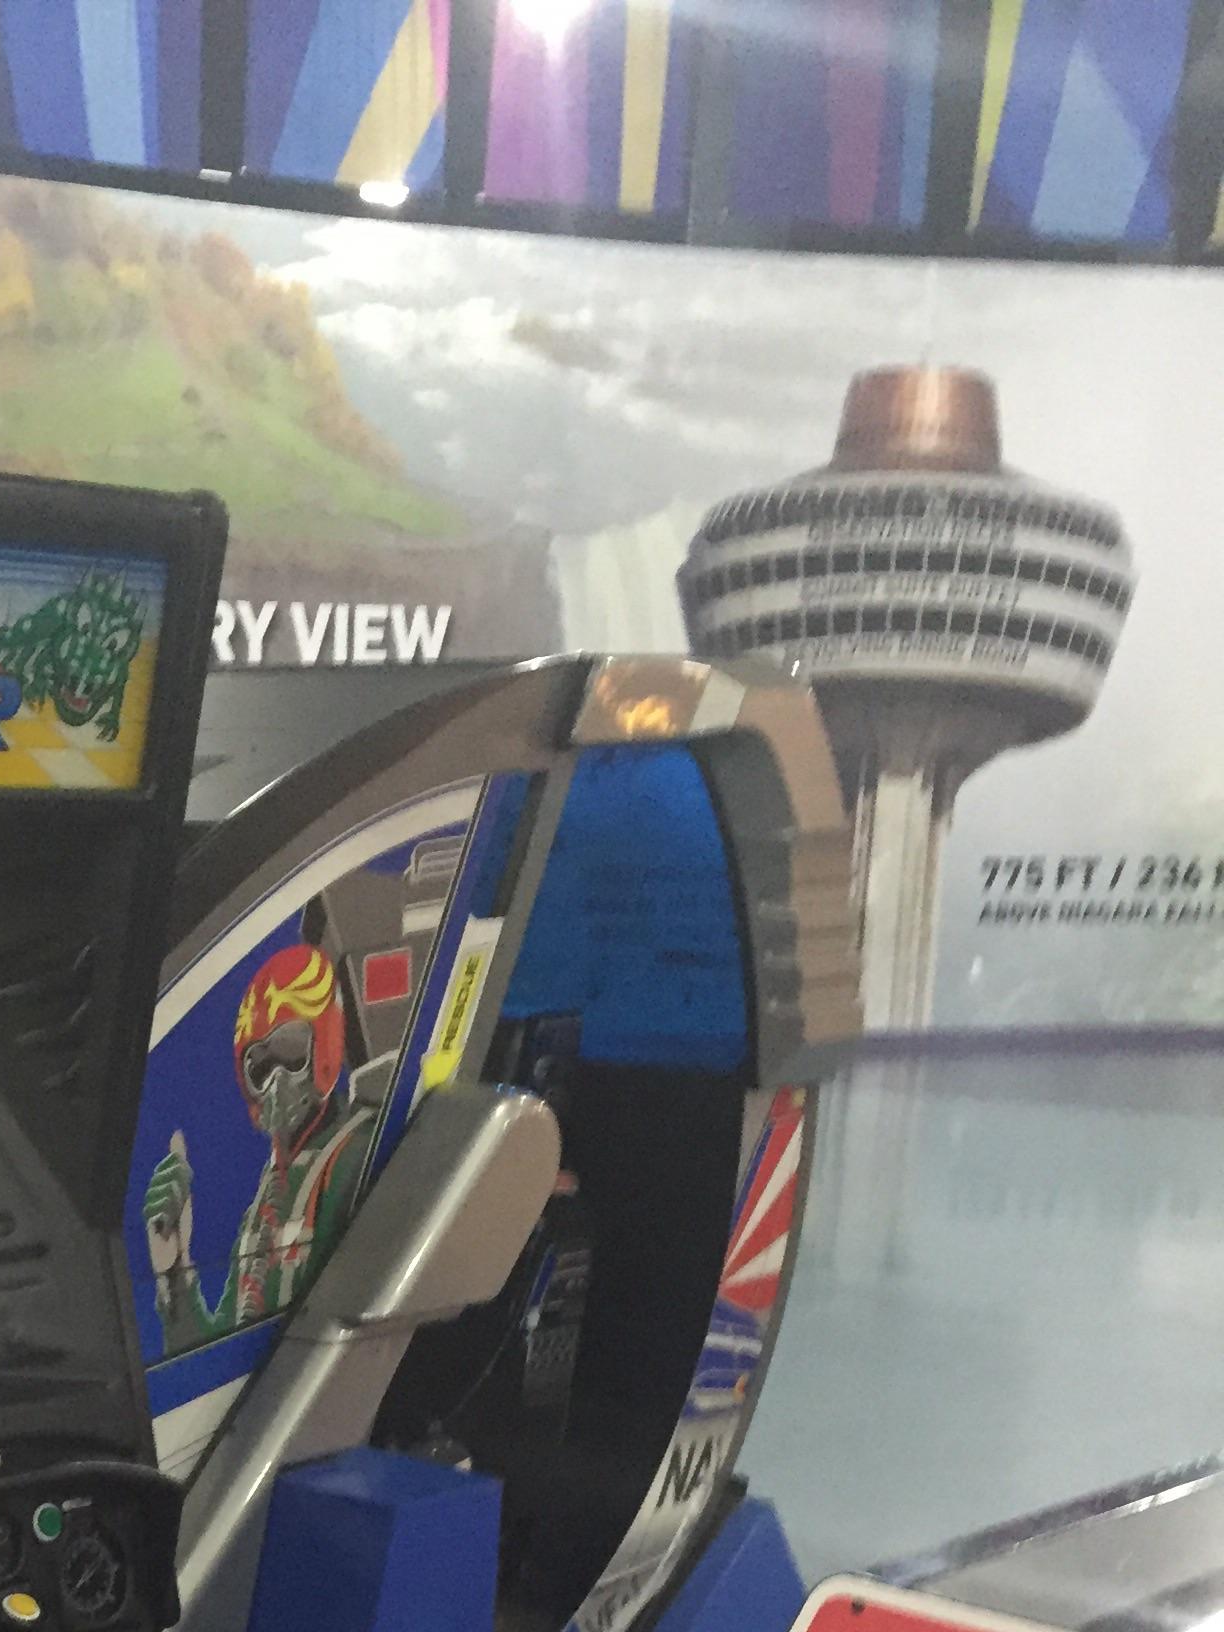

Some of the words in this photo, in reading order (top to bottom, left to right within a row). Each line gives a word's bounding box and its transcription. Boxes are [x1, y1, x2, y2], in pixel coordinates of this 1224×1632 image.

[289, 601, 453, 668] VIEW
[981, 856, 1047, 893] 775
[1053, 856, 1103, 892] FT
